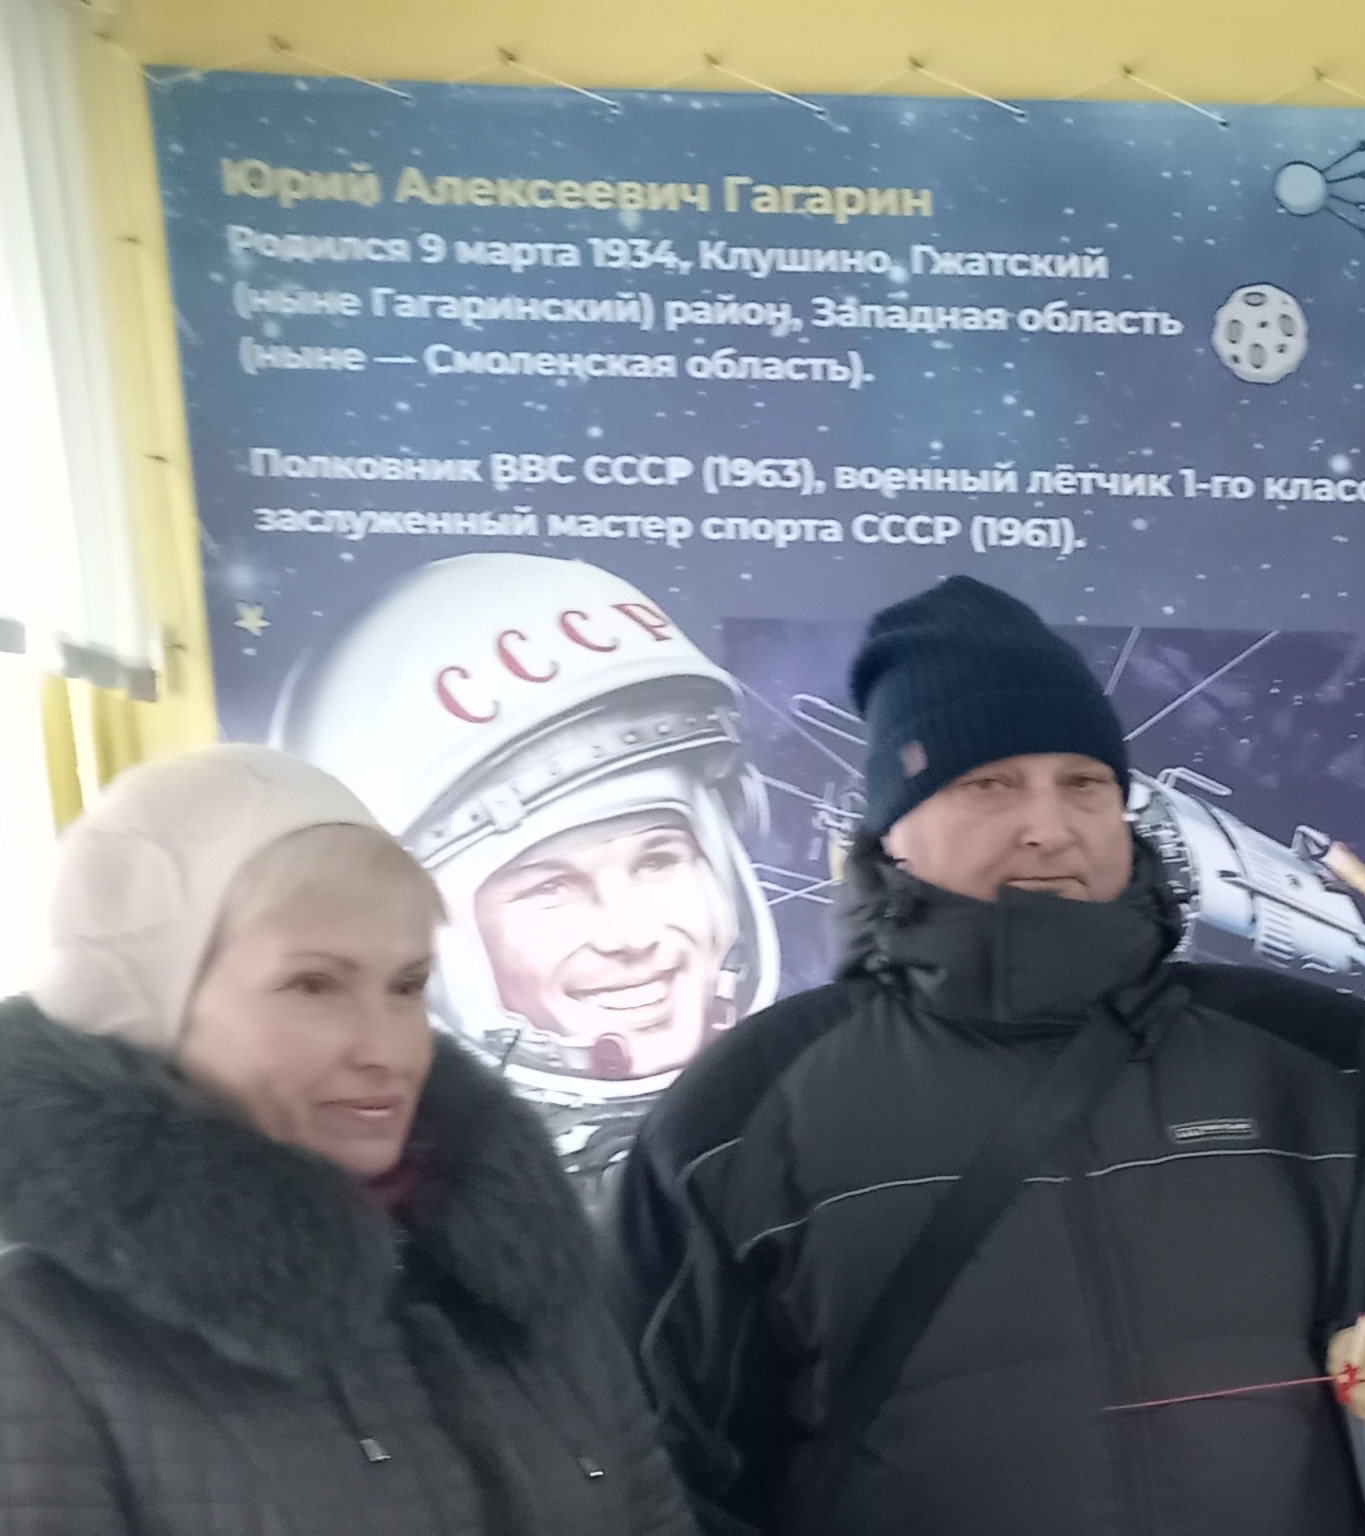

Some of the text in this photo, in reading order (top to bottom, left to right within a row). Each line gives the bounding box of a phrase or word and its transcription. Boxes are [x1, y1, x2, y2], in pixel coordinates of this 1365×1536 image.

[221, 158, 933, 224] Юрий Алексеевич Гагарин
[226, 223, 1110, 280] Родился 9 марта 1934, Клушино, Гжатский
[232, 281, 1184, 337] (ныне Гагаринский) район, Западная область
[238, 335, 366, 374] (ныне
[423, 343, 678, 379] Смоленская
[684, 347, 876, 390] область).
[249, 446, 483, 484] Полковник
[490, 452, 577, 487] ВВС
[583, 454, 695, 487] СССР
[702, 456, 828, 495] (1963),
[834, 461, 1019, 497] военный
[1026, 465, 1173, 498] лётчик
[1179, 467, 1257, 501] 1-го
[253, 506, 1087, 555] заслуженный мастер спорта СССР (1961).
[434, 602, 673, 724] СССР
